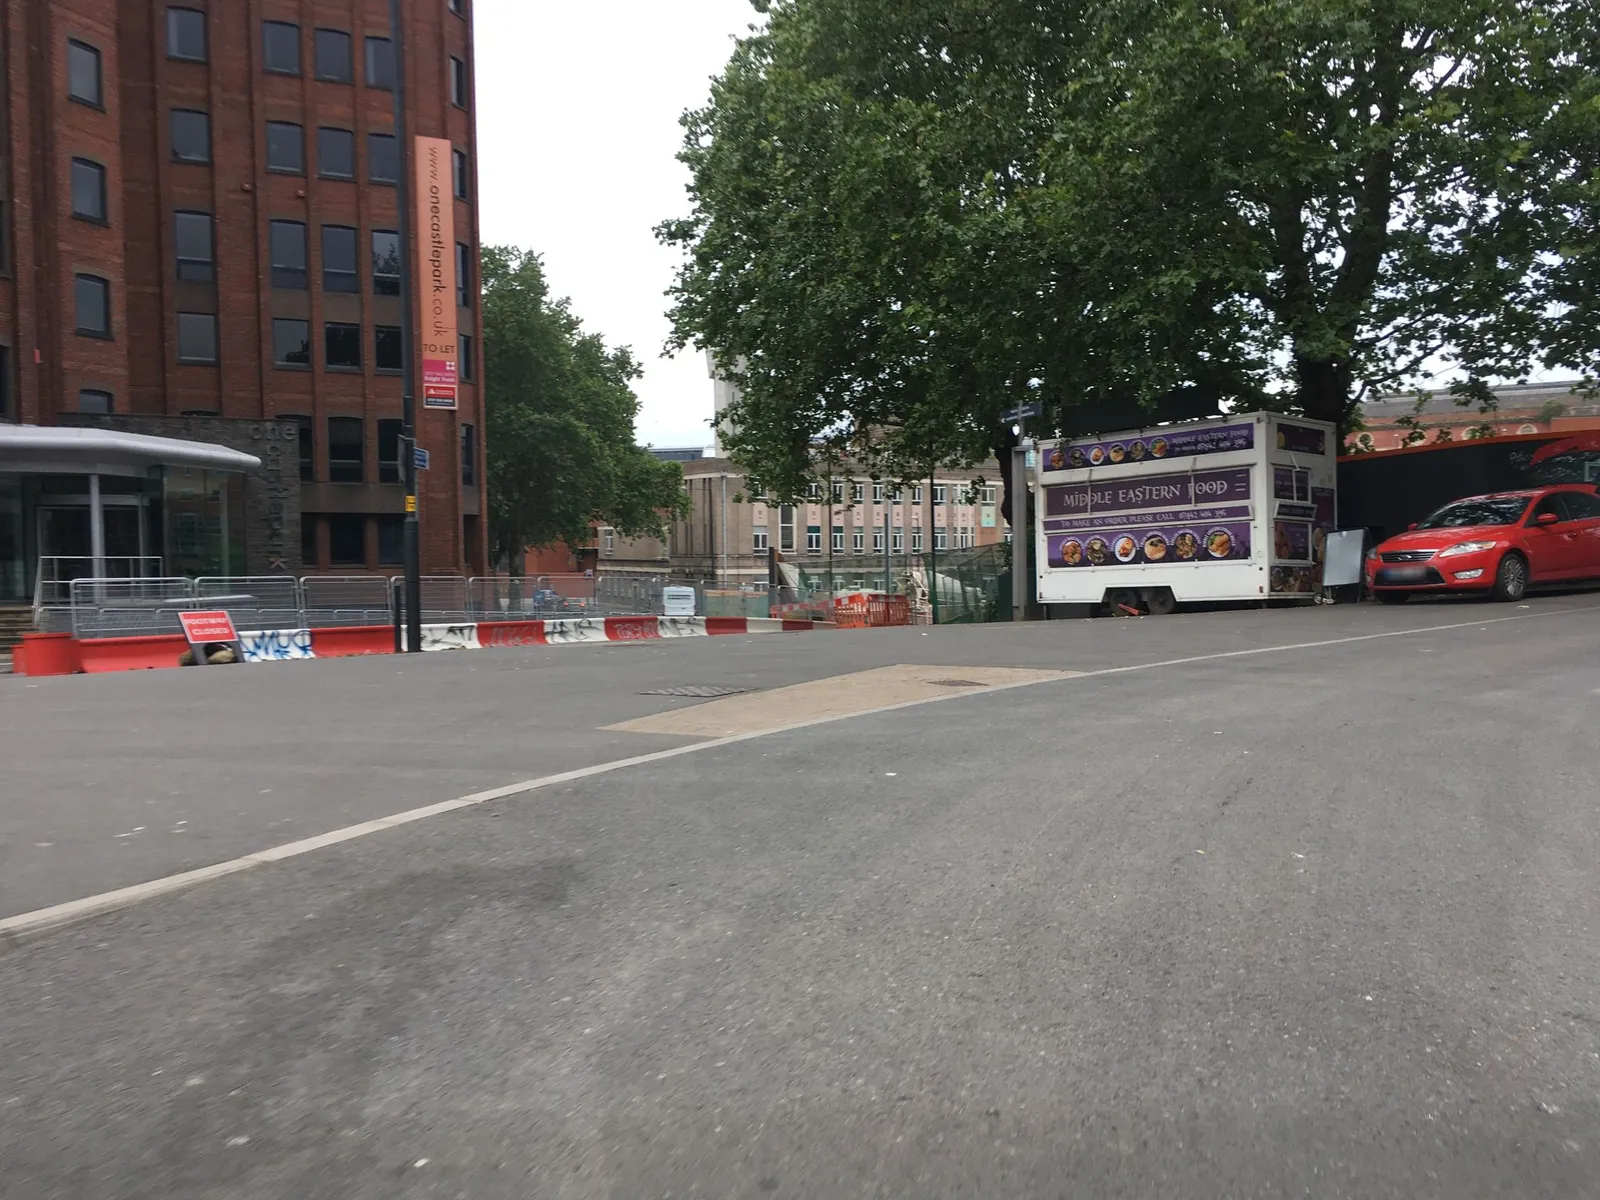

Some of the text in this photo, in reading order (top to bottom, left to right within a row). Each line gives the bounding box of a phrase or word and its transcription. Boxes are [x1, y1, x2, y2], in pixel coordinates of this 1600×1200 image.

[428, 147, 449, 338] www.onecastlepark.co.uk
[422, 343, 455, 354] TO LET
[250, 422, 297, 440] one
[1118, 483, 1183, 503] EASTERN
[1129, 514, 1155, 523] PLEASE
[1156, 513, 1175, 521] CALL
